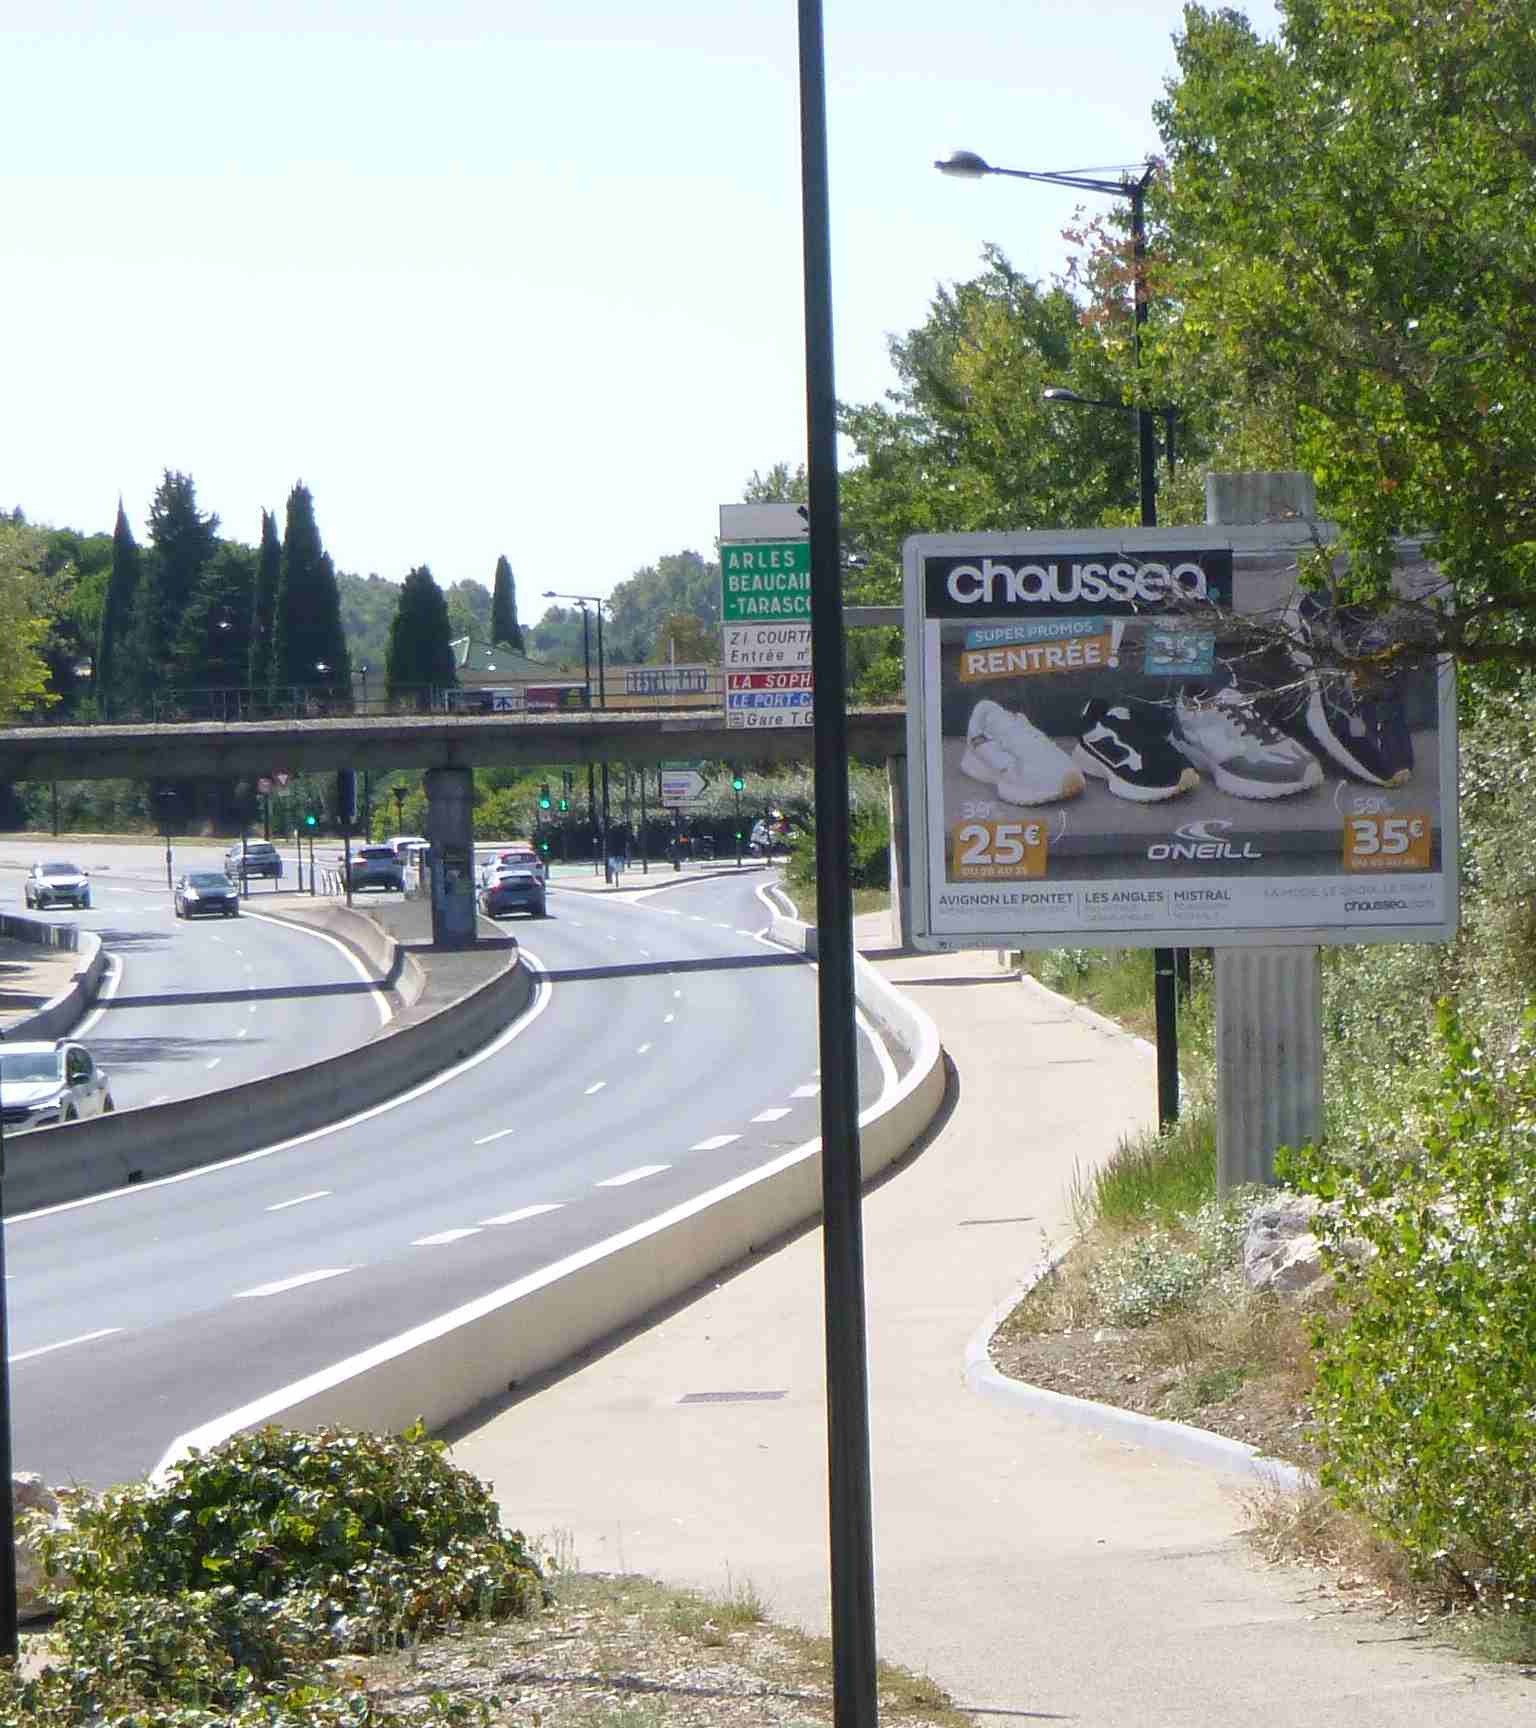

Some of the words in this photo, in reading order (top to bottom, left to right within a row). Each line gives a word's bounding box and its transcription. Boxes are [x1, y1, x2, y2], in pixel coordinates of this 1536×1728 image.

[729, 551, 795, 568] ARLES
[975, 624, 1025, 642] SUPER
[1028, 621, 1094, 640] PROMOS
[730, 648, 784, 662] Entrée
[967, 639, 1102, 674] RENTRÉE
[733, 675, 752, 689] LA
[733, 694, 751, 708] LE
[747, 713, 784, 726] Gare
[1351, 818, 1424, 855] 35€
[959, 824, 1040, 865] 25€
[939, 894, 1002, 905] AVIGNON
[1003, 894, 1018, 905] LE
[1021, 893, 1074, 904] PONTET
[1084, 892, 1108, 903] LES
[1112, 891, 1163, 903] ANGLES
[1174, 889, 1232, 901] MISTRAL
